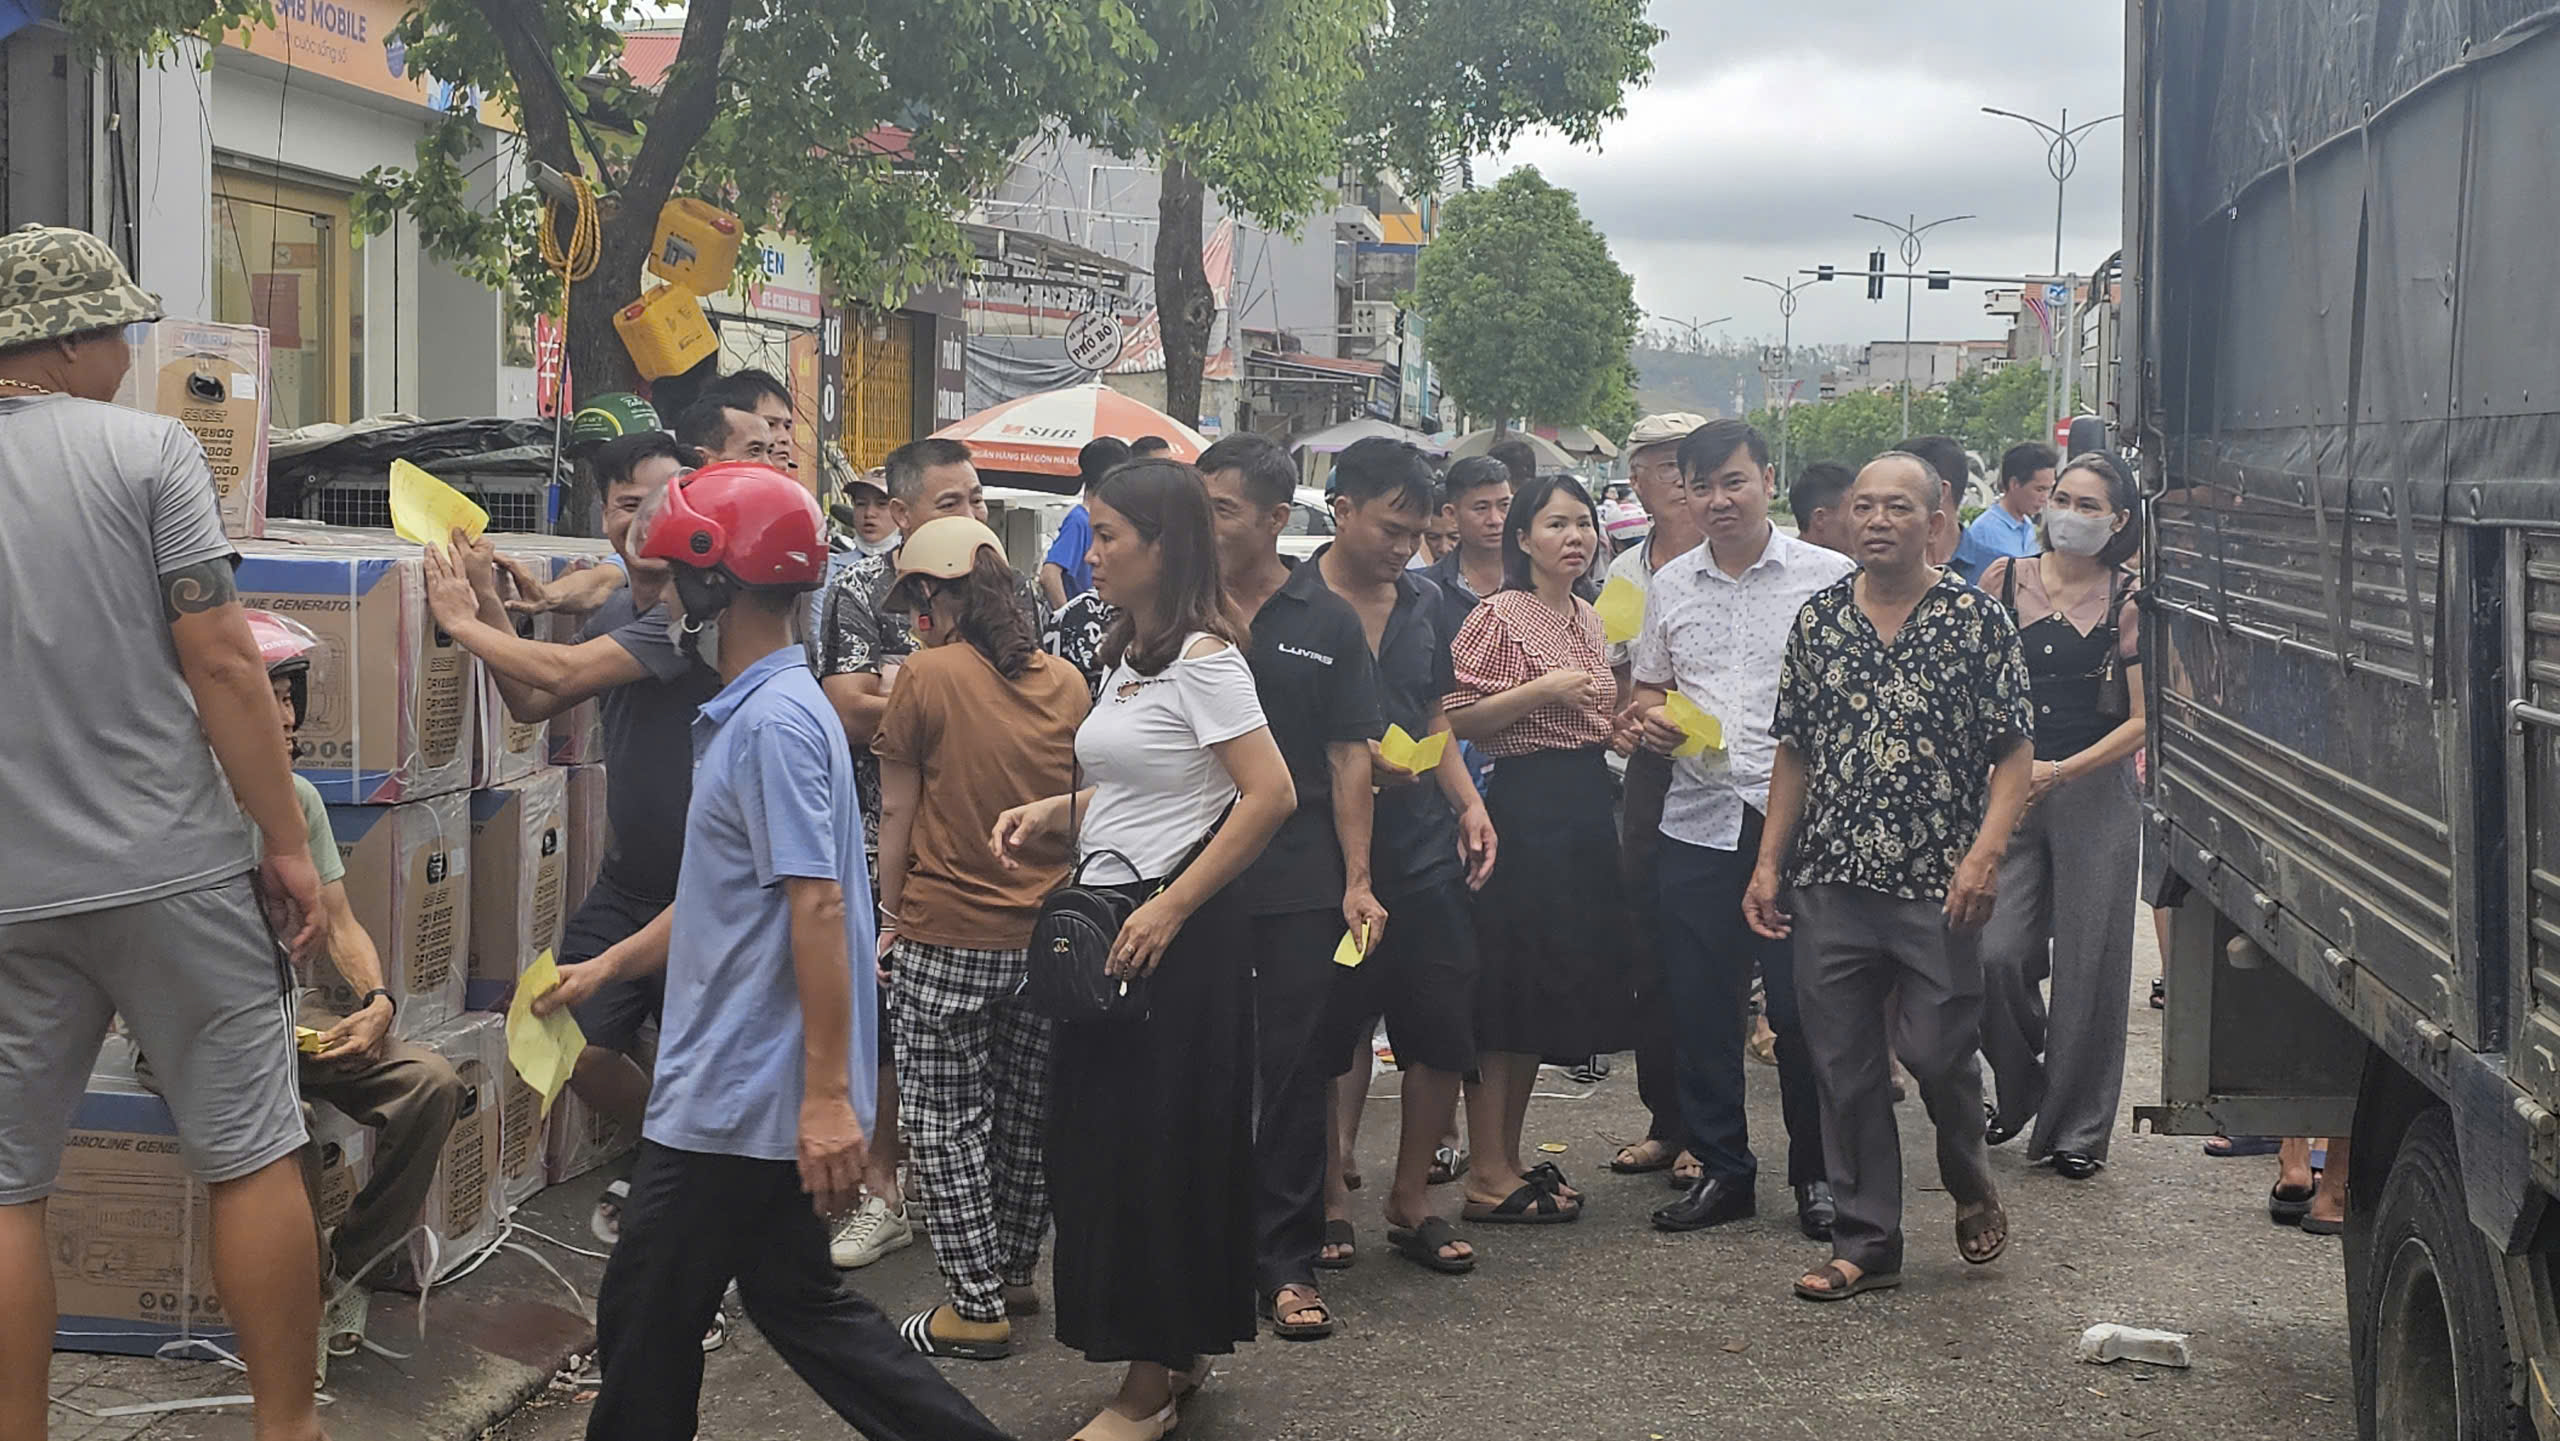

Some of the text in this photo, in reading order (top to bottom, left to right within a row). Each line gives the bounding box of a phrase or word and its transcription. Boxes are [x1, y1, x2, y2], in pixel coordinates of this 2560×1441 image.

[311, 1, 367, 43] MOBILE
[1024, 425, 1077, 439] SHB
[136, 1140, 181, 1154] GENE
